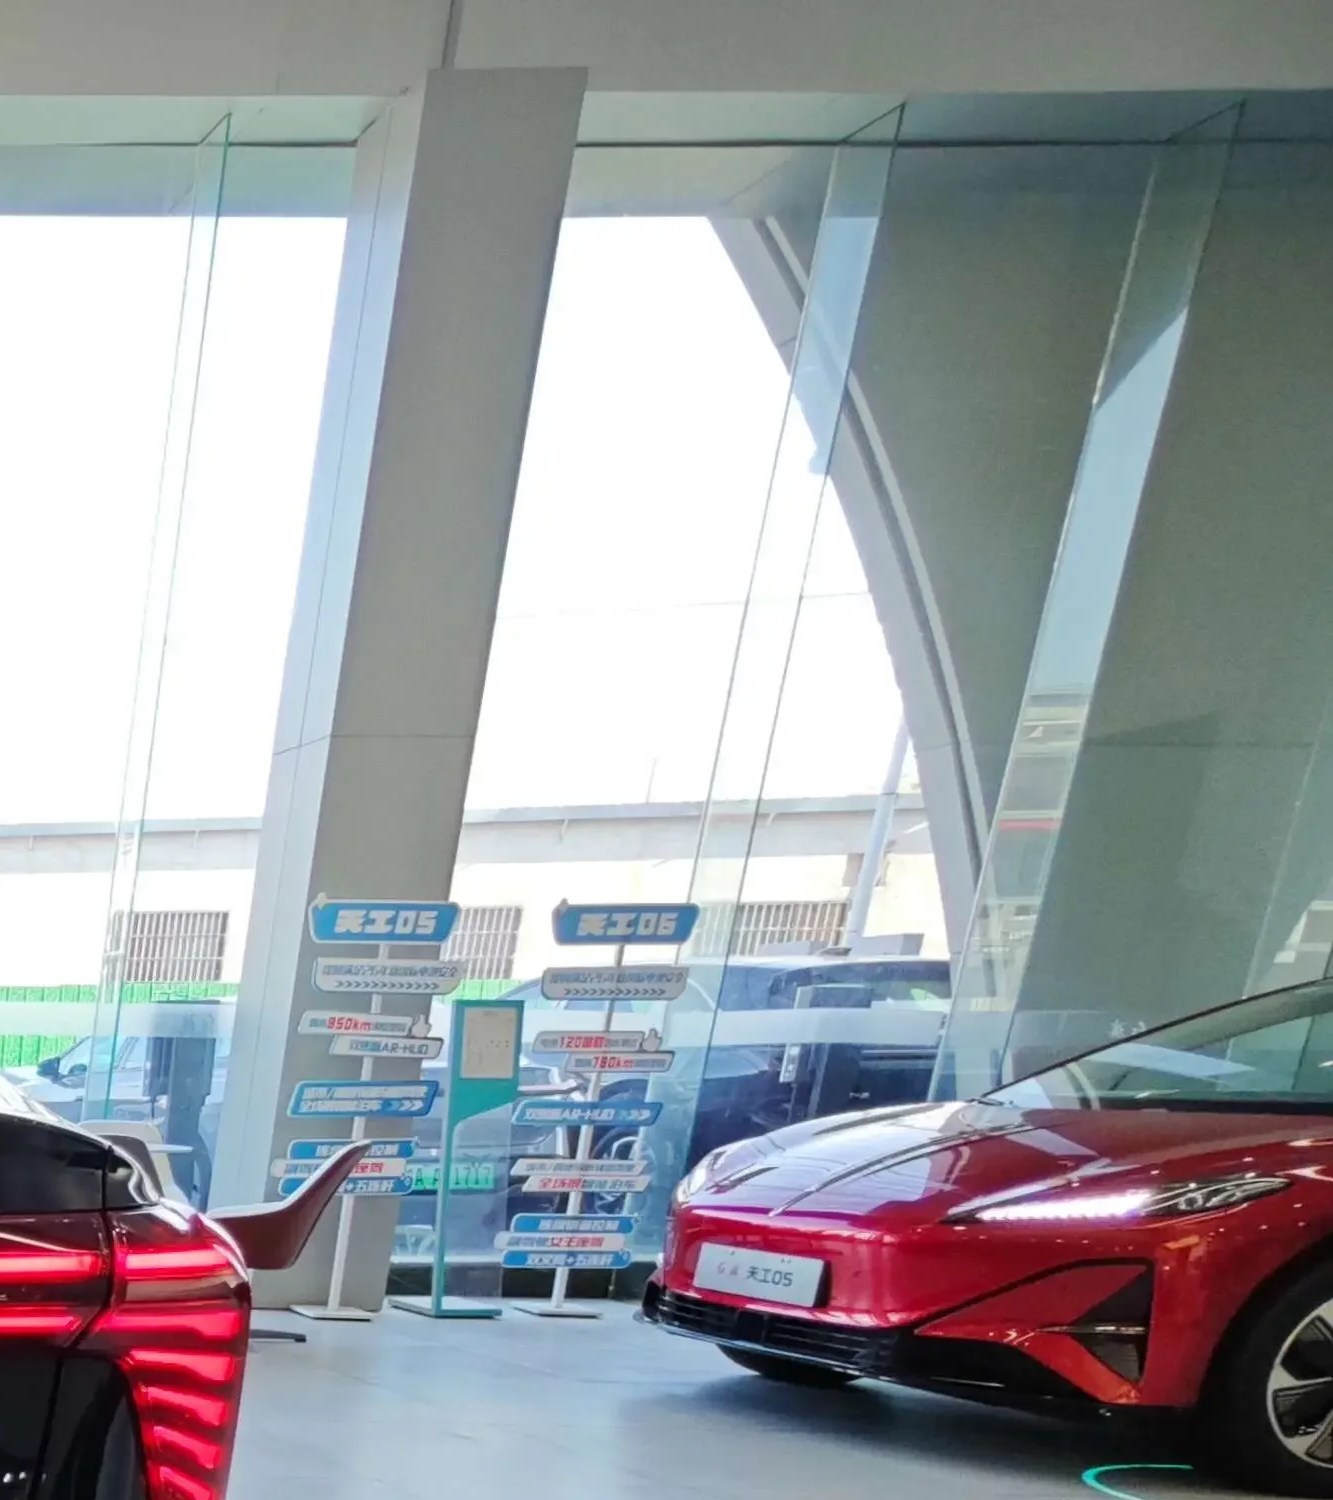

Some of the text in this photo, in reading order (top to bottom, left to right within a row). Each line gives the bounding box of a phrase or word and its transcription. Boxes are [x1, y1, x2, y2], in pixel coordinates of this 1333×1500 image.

[334, 909, 438, 934] 天工05
[576, 912, 679, 936] 天工06
[746, 1266, 793, 1287] 天工05
